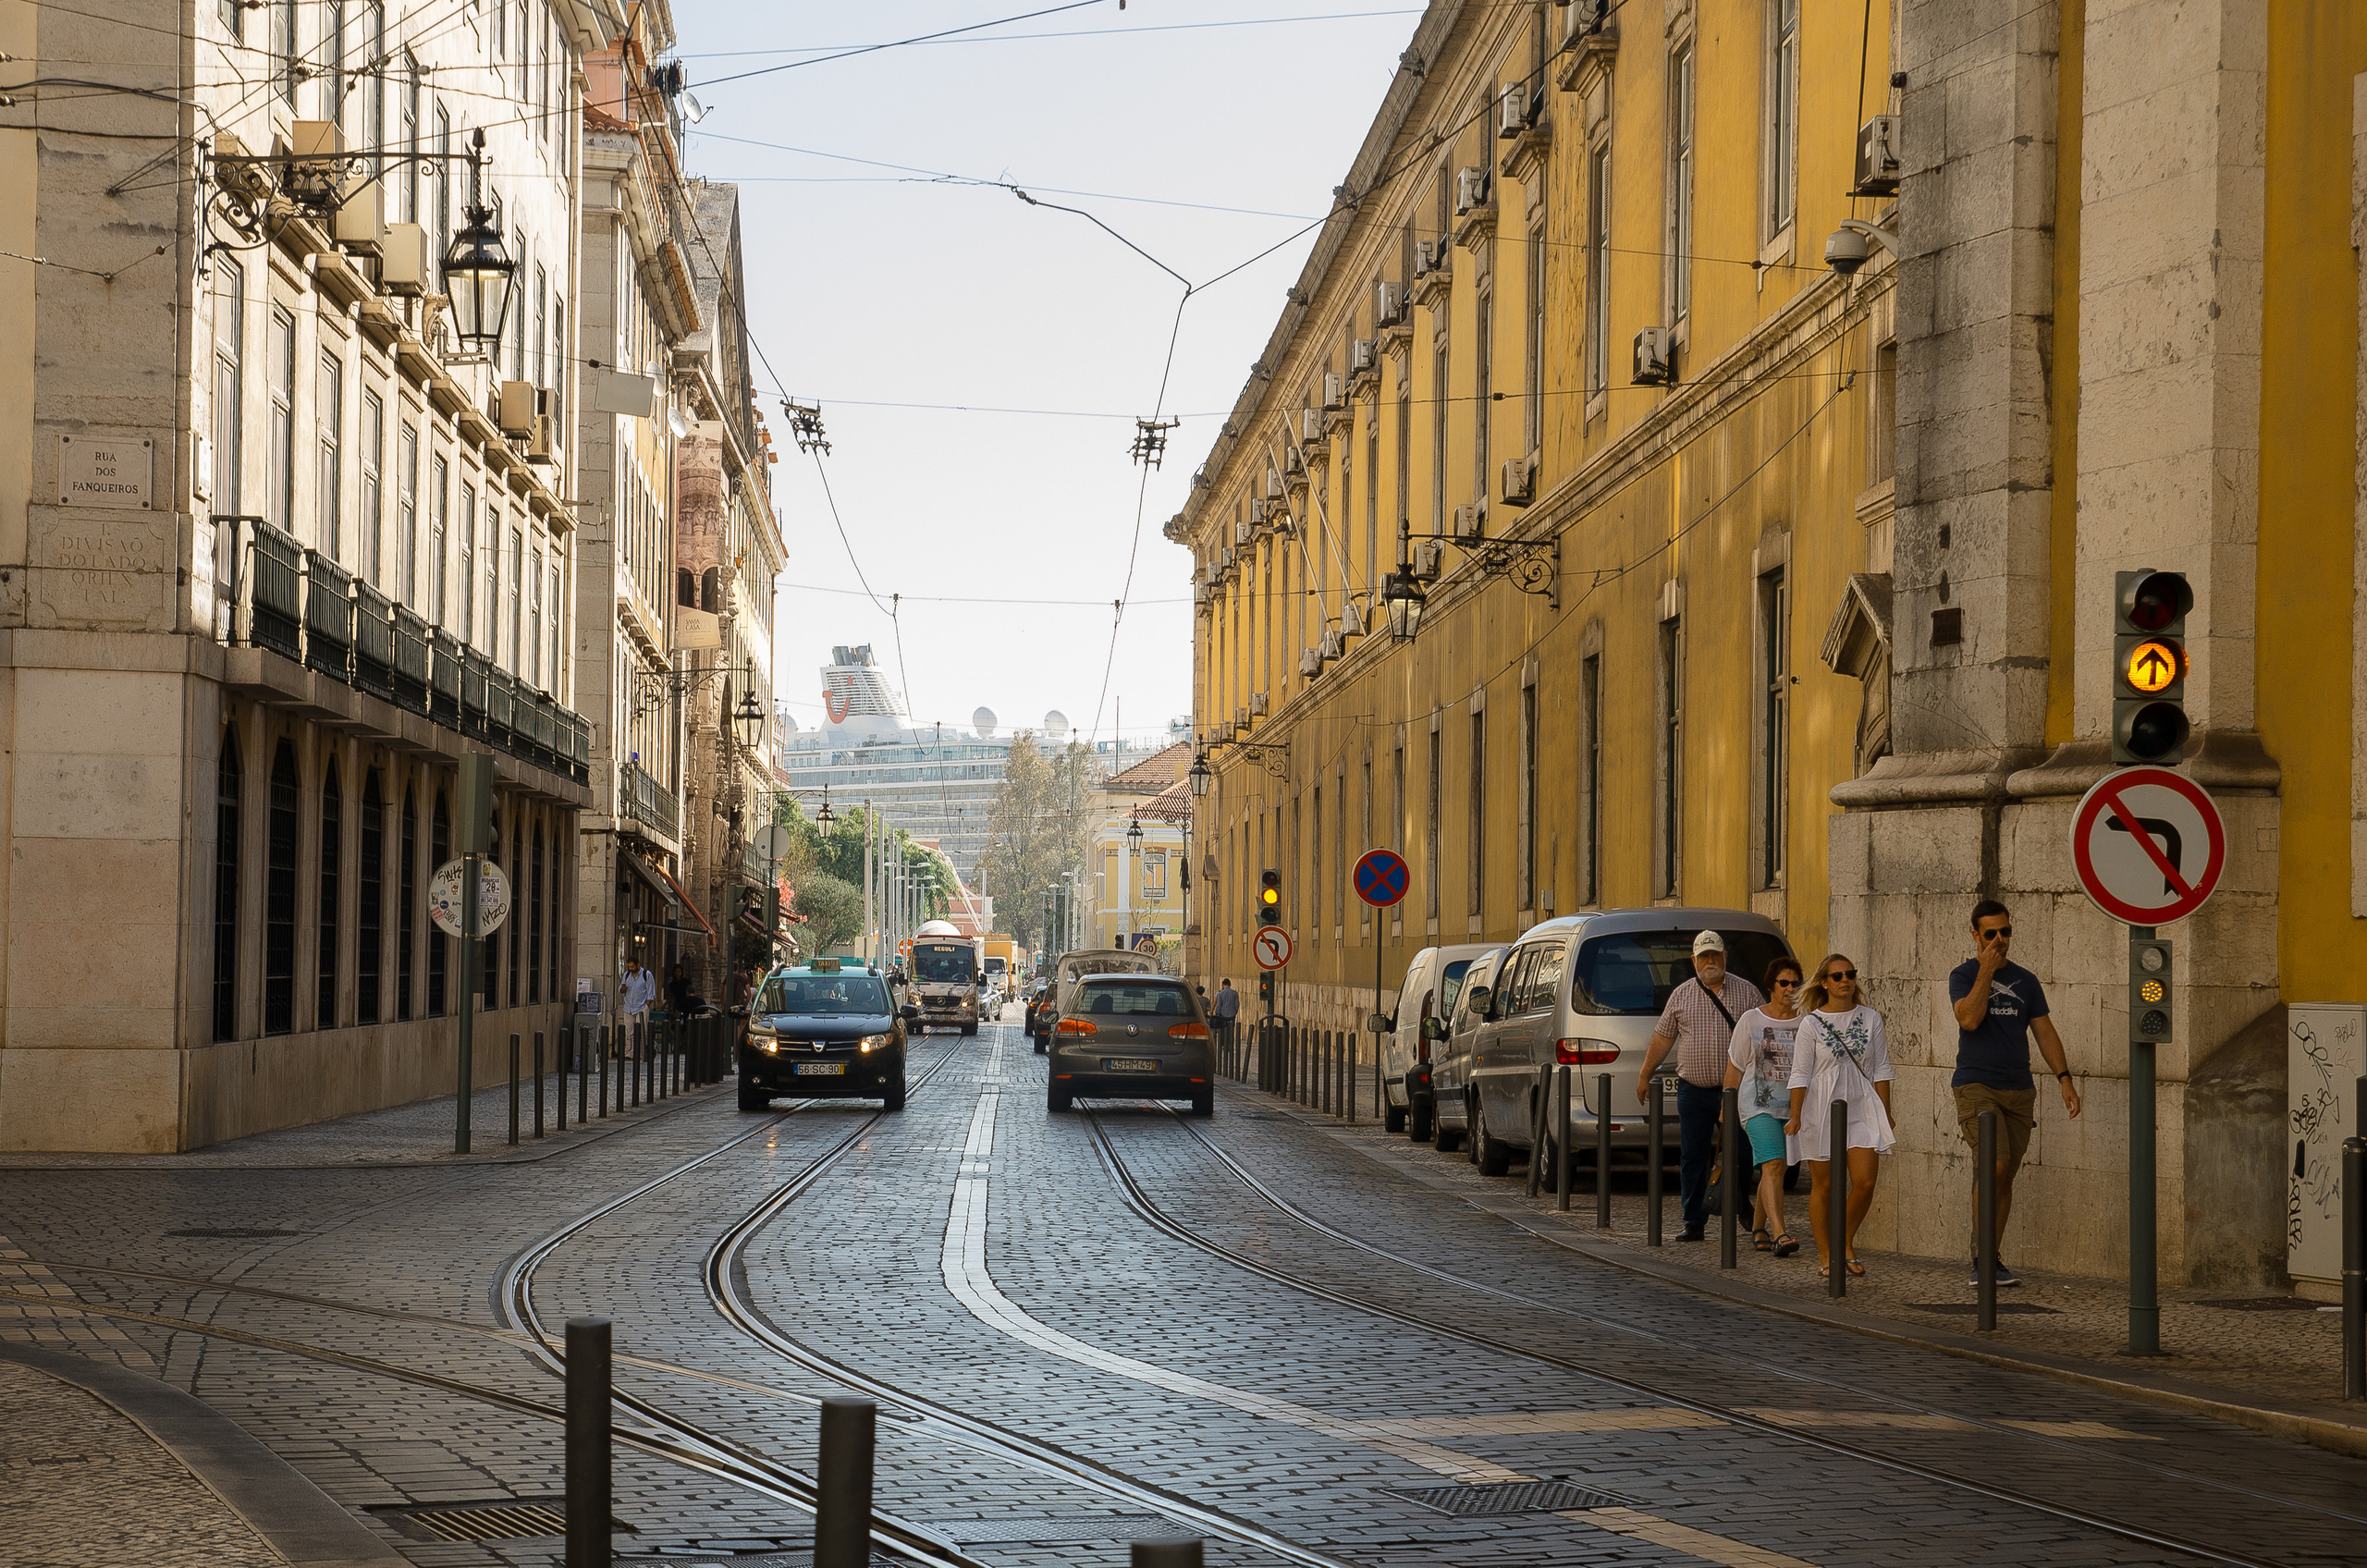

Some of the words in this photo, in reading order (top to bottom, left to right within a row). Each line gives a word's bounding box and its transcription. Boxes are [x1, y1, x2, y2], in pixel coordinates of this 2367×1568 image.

[95, 452, 117, 461] RUA
[95, 467, 117, 476] DOS
[72, 482, 139, 495] FANQUEIROS
[1143, 944, 1154, 952] 30
